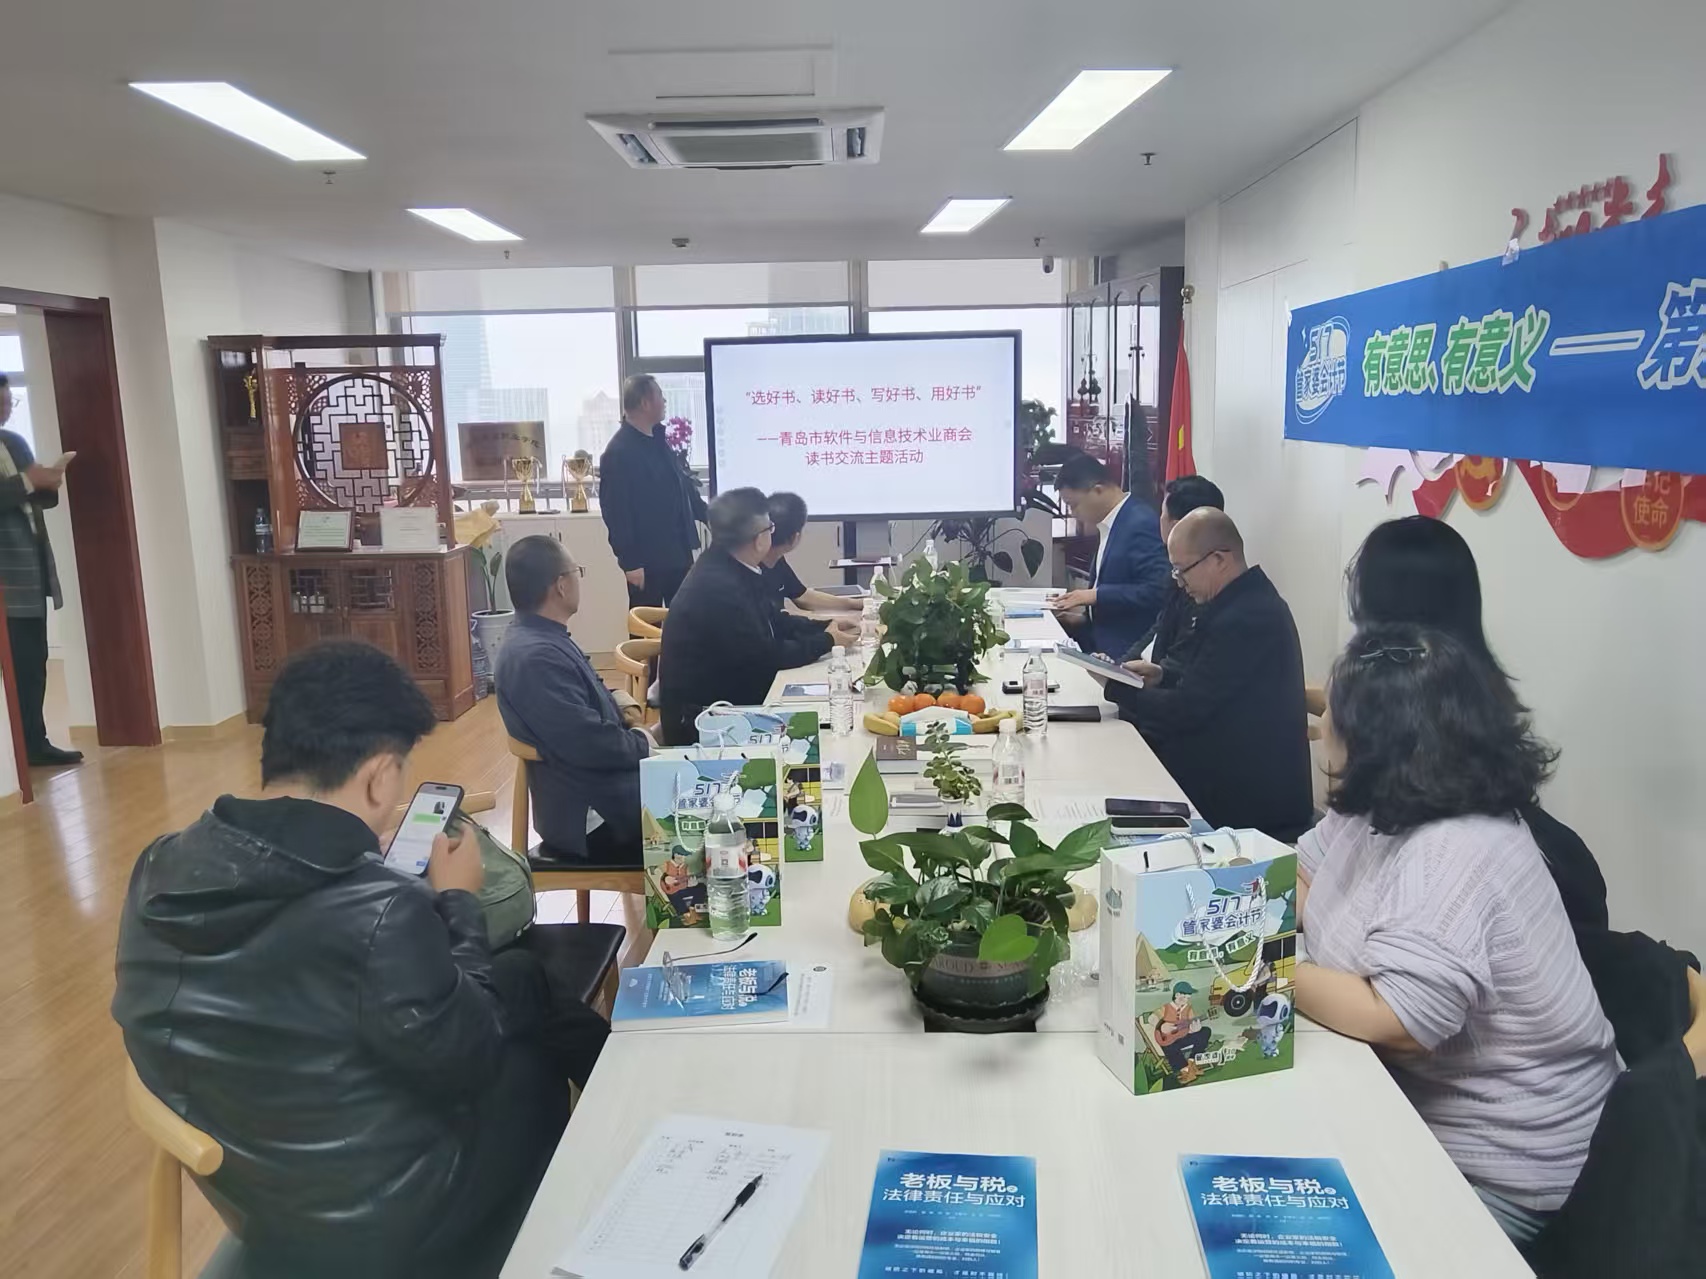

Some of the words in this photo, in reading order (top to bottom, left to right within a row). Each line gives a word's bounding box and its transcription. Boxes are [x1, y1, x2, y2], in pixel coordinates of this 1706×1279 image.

[805, 449, 924, 465] 读书交流主题活动
[1633, 496, 1669, 528] 使命
[750, 733, 772, 744] 517
[695, 783, 720, 796] 517
[1207, 896, 1240, 915] 517
[883, 1188, 1026, 1208] 法律责任与应对
[1201, 1193, 1350, 1210] 法律责任与应对
